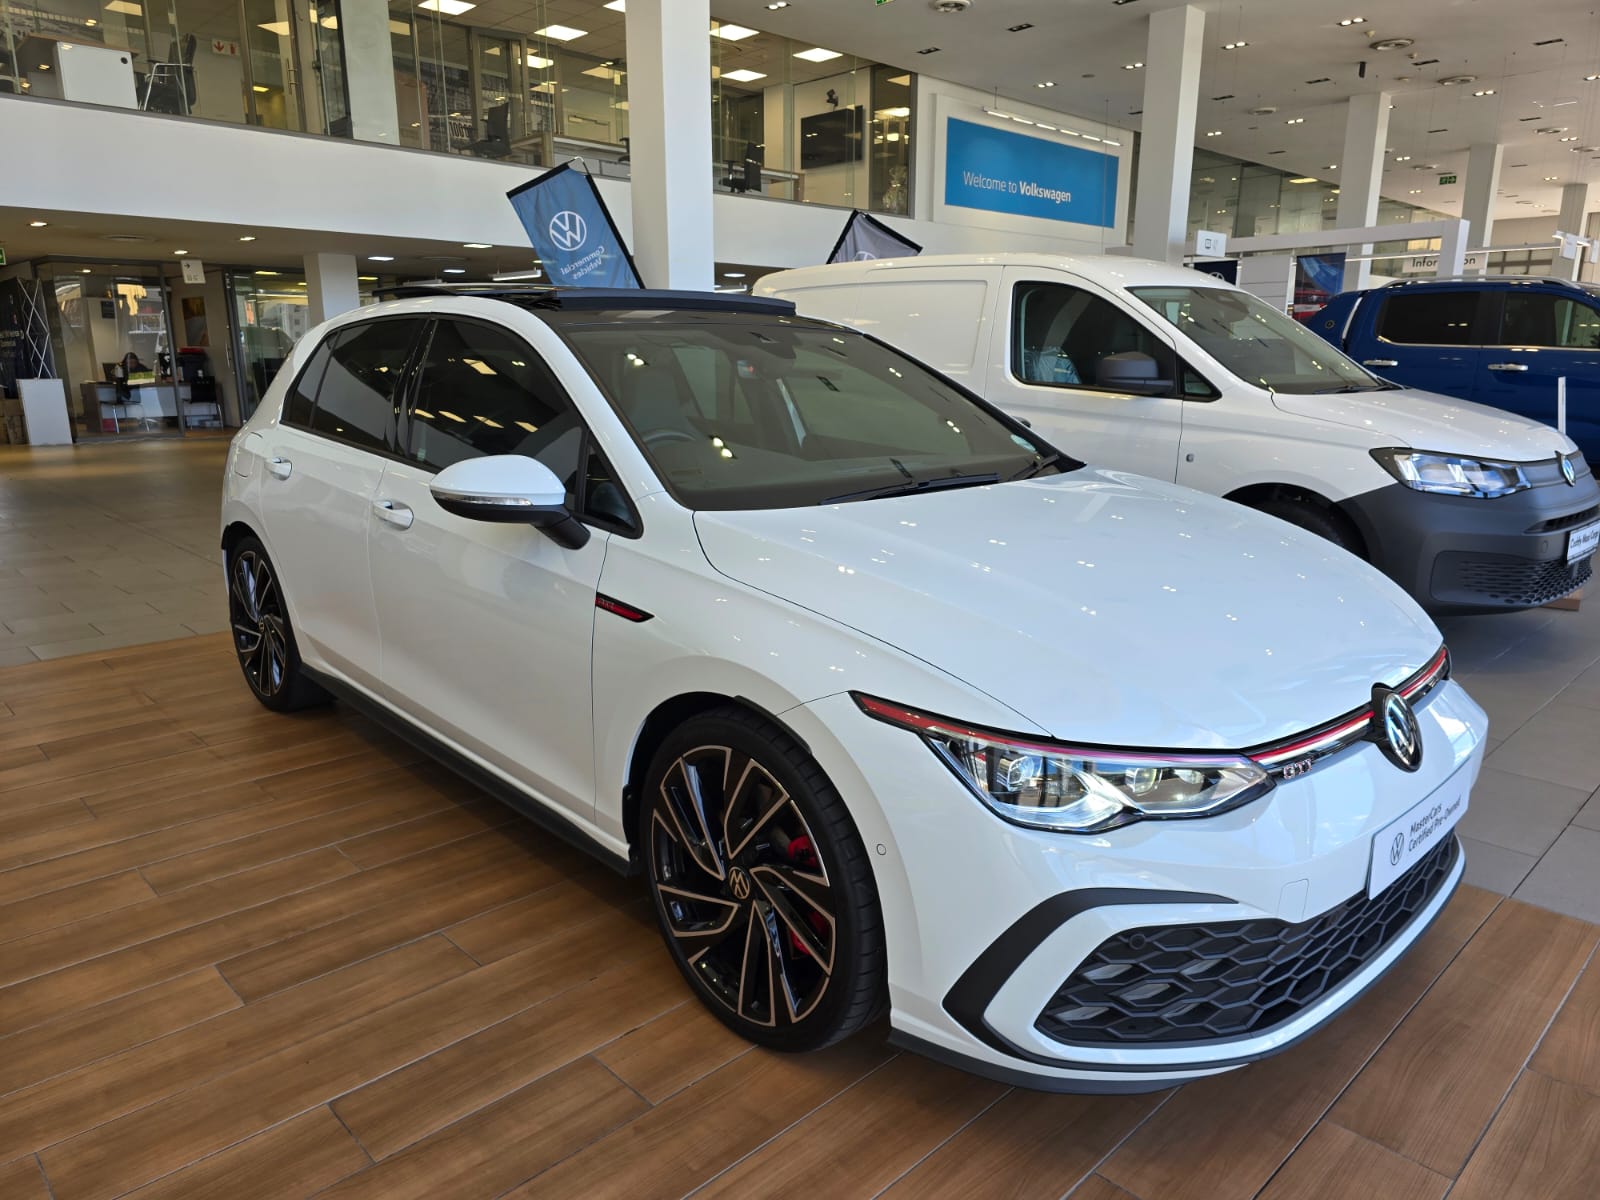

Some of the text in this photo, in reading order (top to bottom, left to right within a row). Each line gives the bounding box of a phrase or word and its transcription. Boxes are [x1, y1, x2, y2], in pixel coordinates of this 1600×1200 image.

[963, 170, 1072, 204] Welcome to Volkswagen
[1283, 758, 1313, 780] GTI
[1409, 803, 1442, 837] MasterCars
